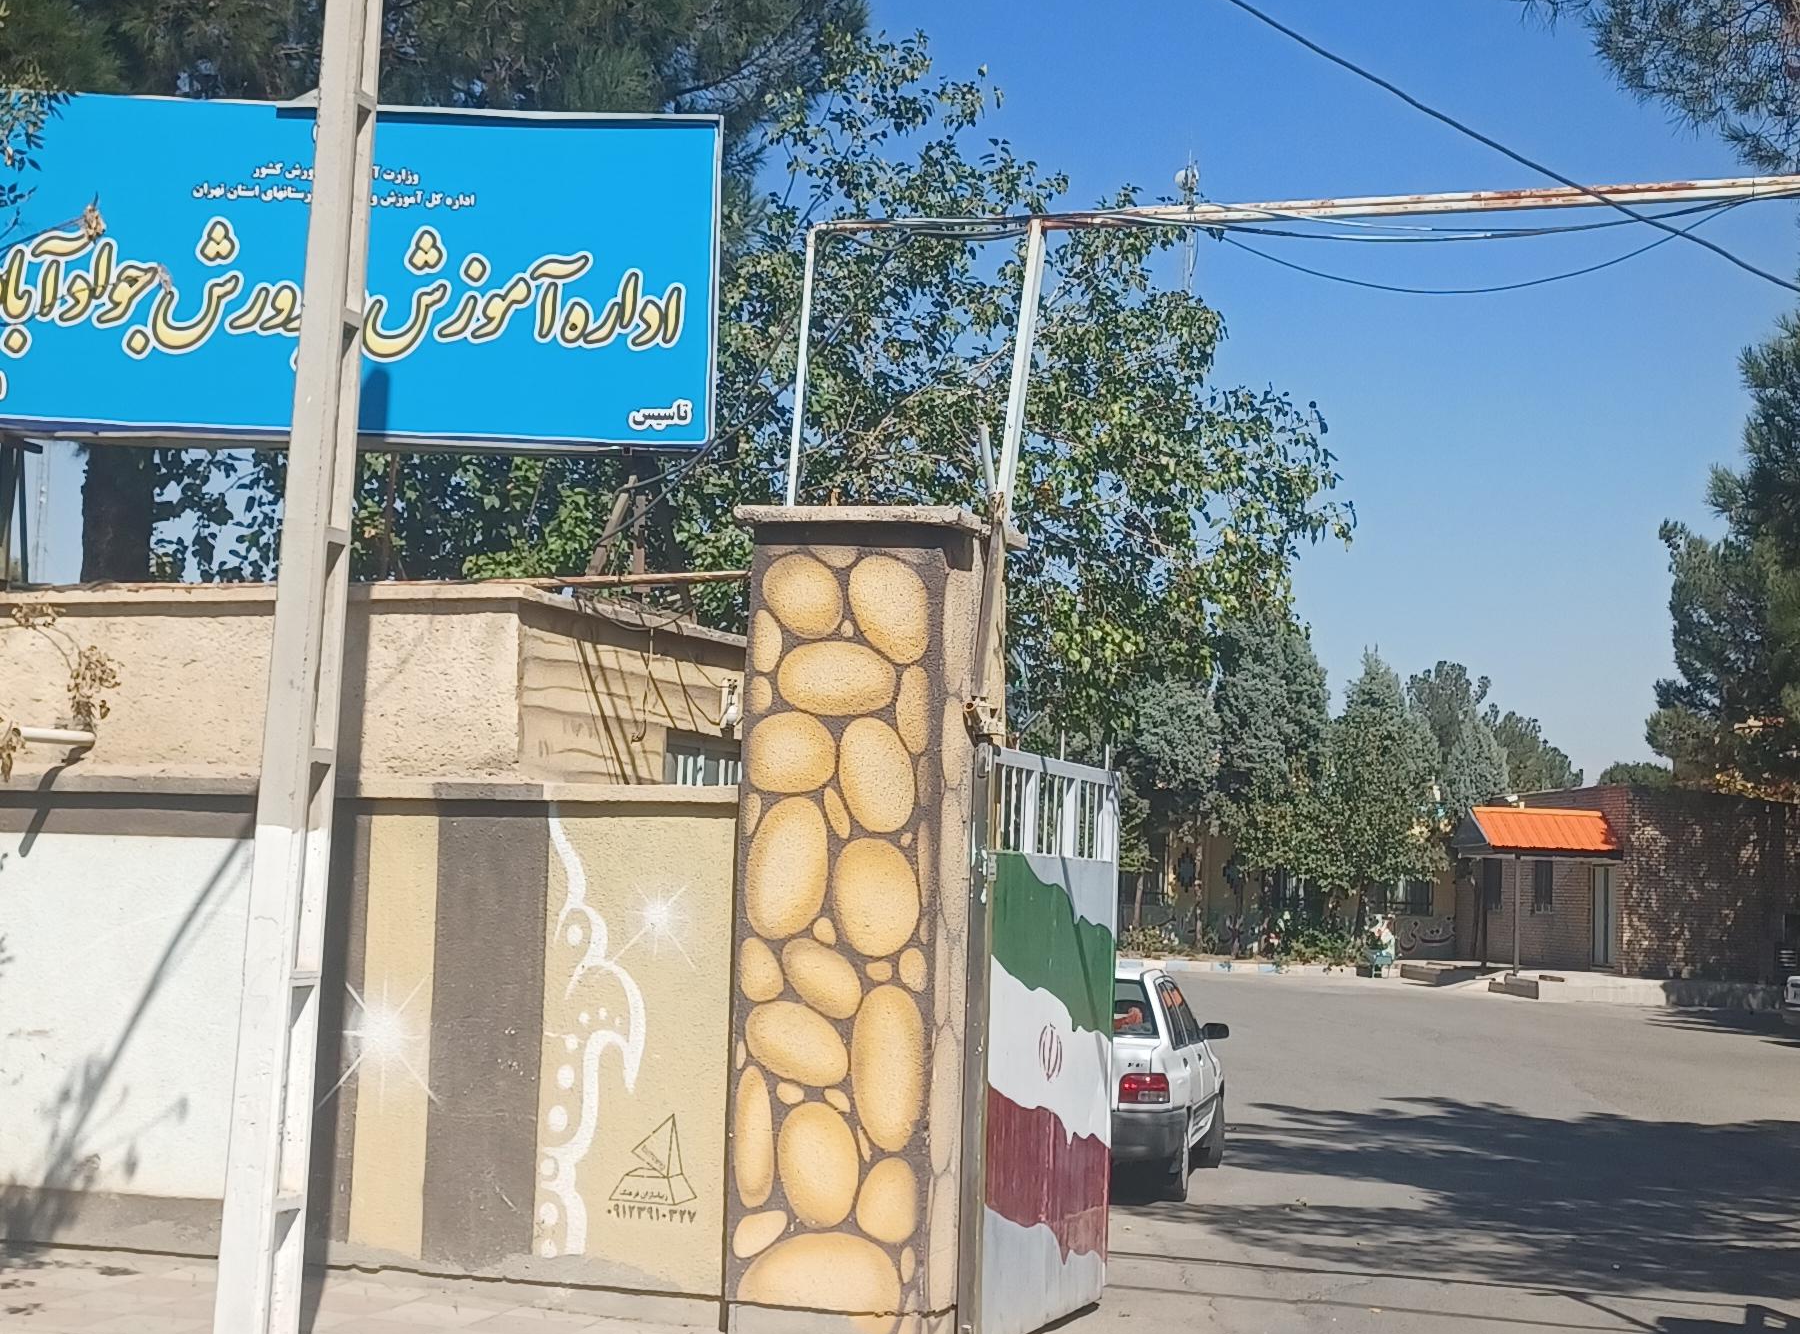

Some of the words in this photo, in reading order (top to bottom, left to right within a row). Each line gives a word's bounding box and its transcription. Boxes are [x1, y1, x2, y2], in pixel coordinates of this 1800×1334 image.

[252, 162, 283, 178] کشور
[284, 163, 314, 180] ورش
[382, 168, 420, 185] وزارت
[192, 182, 225, 199] تهران
[226, 184, 260, 200] استان
[380, 190, 424, 207] آموزش
[425, 192, 442, 208] کل
[445, 193, 476, 209] اداره
[363, 229, 590, 358] آموزش
[562, 271, 682, 347] اداره
[632, 403, 688, 426] تاسیس
